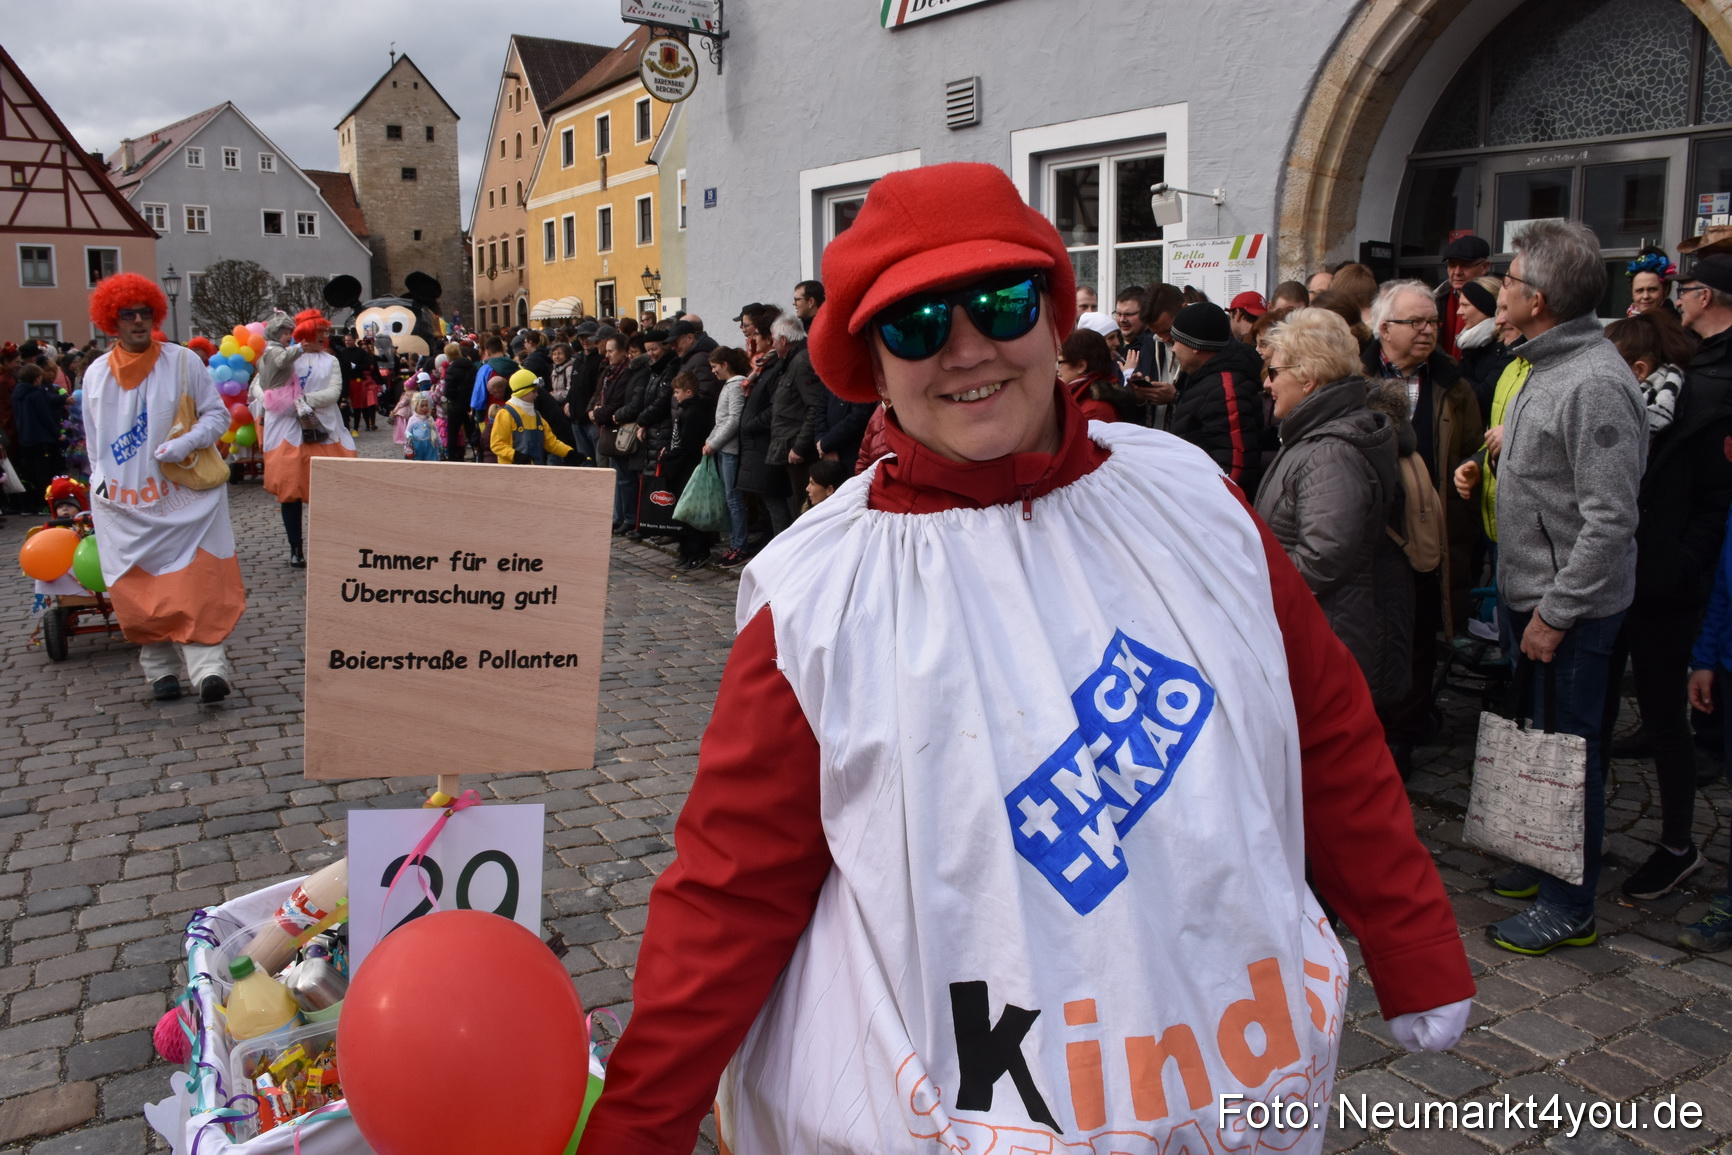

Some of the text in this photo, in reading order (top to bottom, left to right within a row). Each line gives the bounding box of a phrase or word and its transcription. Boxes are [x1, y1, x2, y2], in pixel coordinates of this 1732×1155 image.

[627, 6, 665, 18] Roma
[651, 2, 686, 14] Bella
[656, 85, 682, 95] BERCHING
[1173, 250, 1205, 260] Bella
[1184, 260, 1220, 269] Roma
[358, 549, 543, 572] Immer für eine
[341, 578, 557, 610] Überraschung gut!
[329, 650, 578, 670] Boierstraße Pollanten
